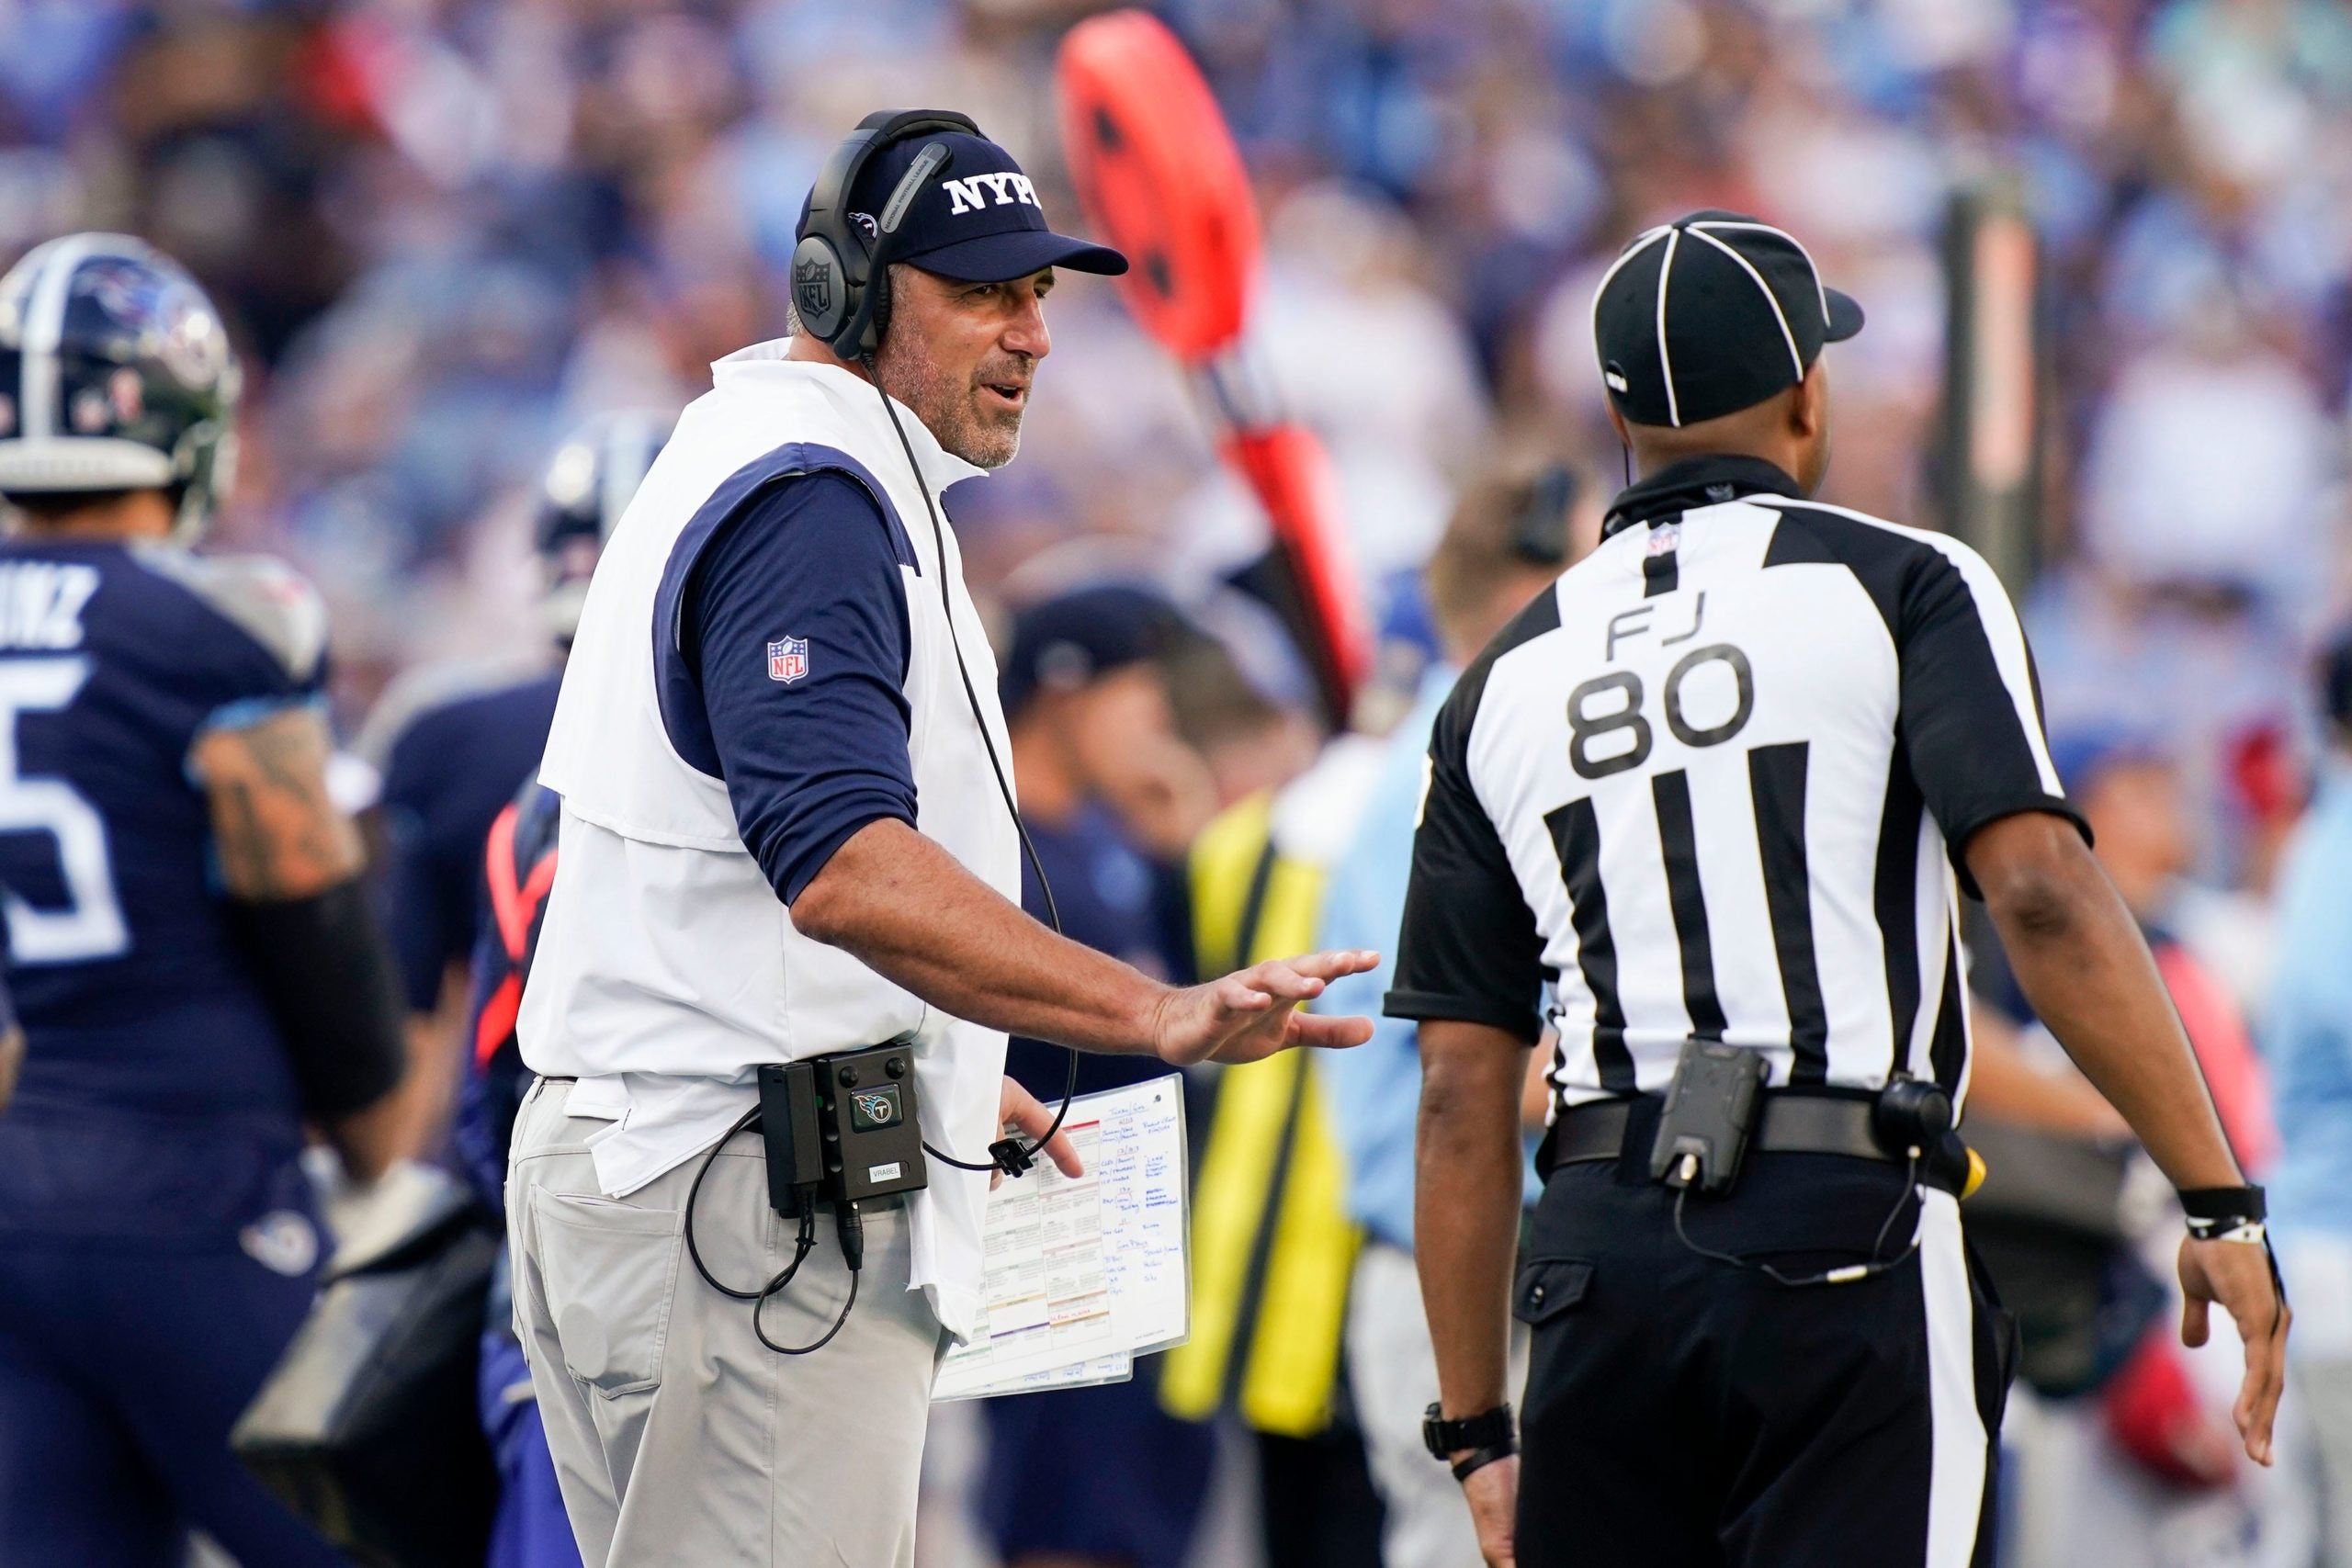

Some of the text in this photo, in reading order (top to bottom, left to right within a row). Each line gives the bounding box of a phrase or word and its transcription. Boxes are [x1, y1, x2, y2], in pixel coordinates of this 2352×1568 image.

[798, 284, 828, 312] NFL
[1606, 591, 1706, 662] FJ
[773, 656, 804, 676] NFL
[1566, 642, 1755, 780] 80
[875, 1105, 888, 1118] T
[873, 1167, 899, 1178] VRABEL
